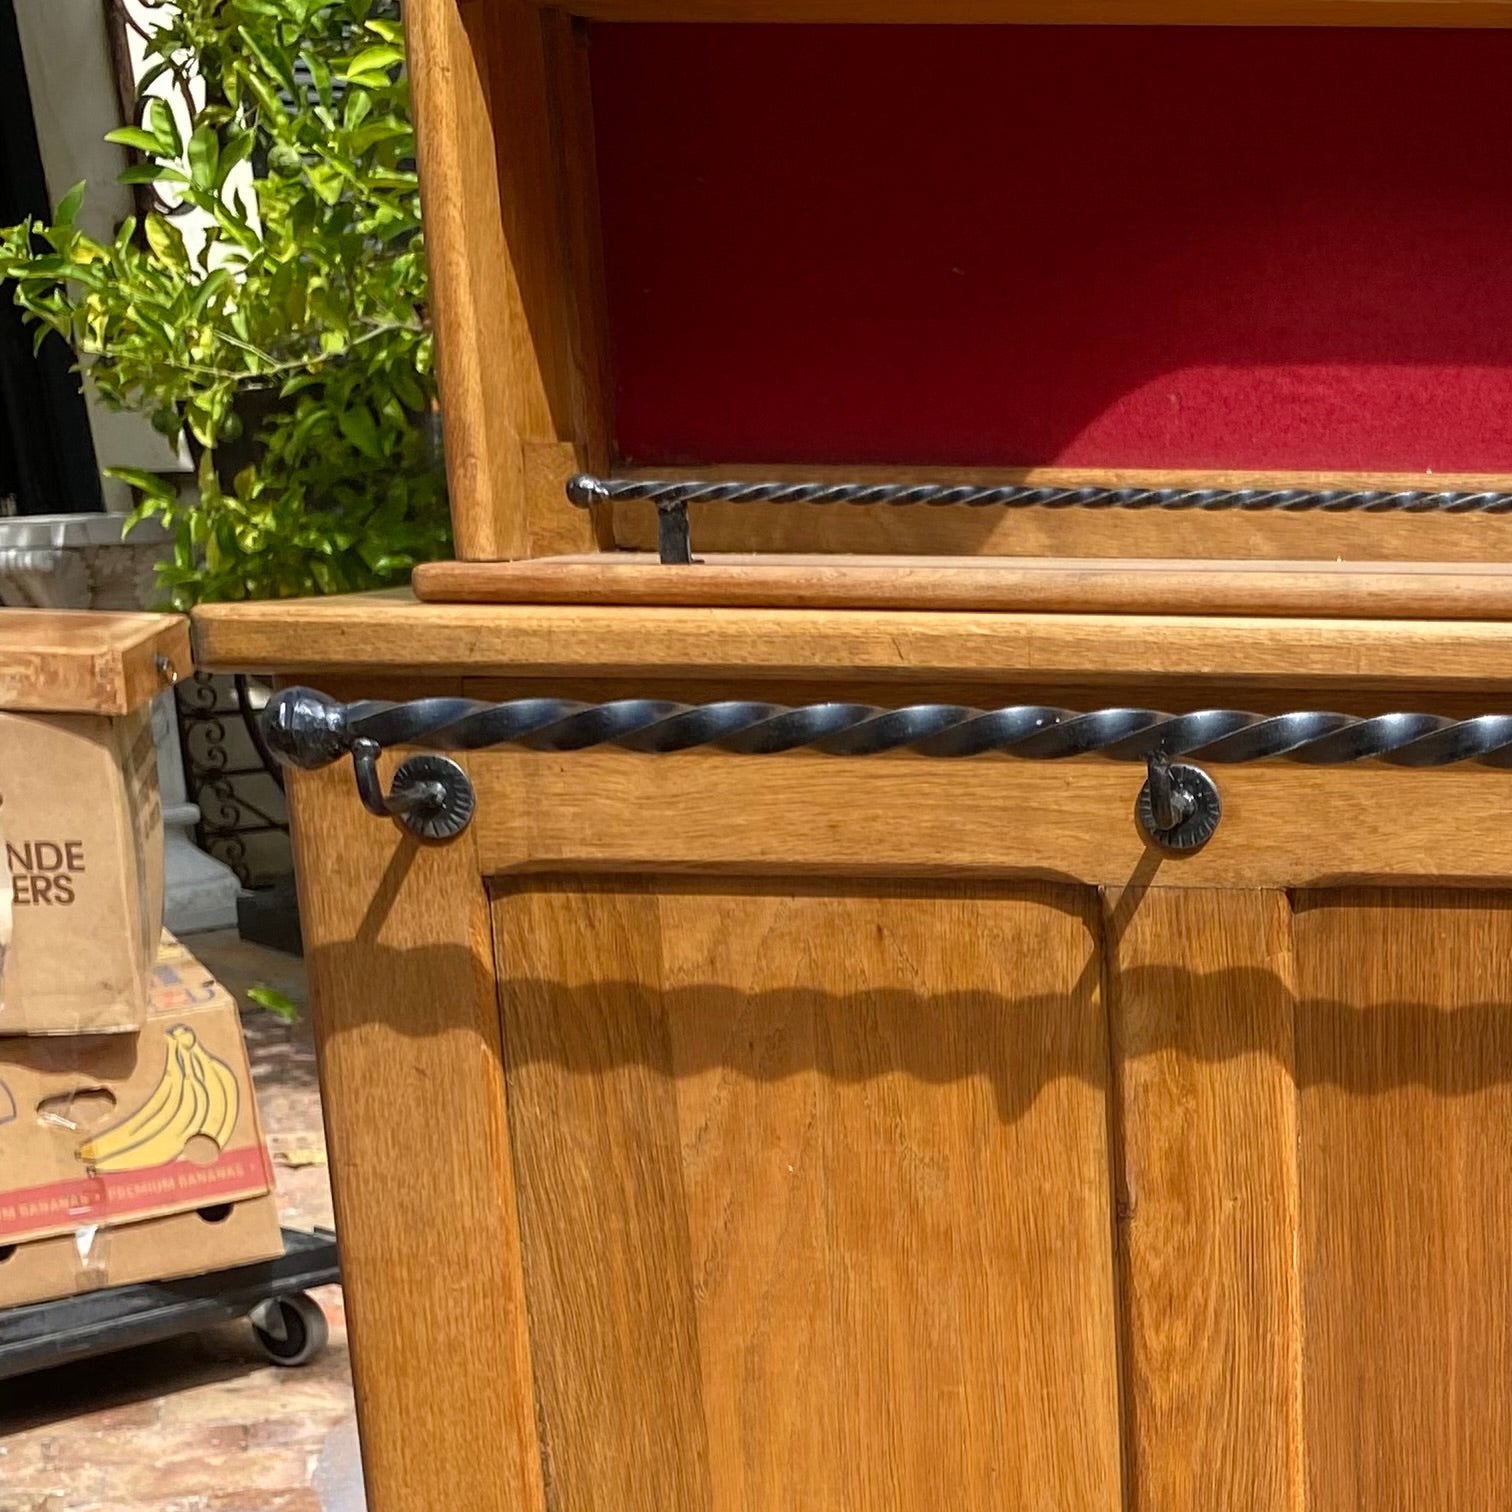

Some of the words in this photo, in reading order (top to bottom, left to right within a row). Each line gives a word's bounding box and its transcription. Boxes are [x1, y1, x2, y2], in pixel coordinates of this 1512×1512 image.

[6, 841, 85, 871] NDE
[13, 875, 75, 904] ERS
[19, 1194, 89, 1217] BANANAS
[108, 1176, 176, 1201] PREMIUM
[178, 1164, 245, 1190] BANANAS
